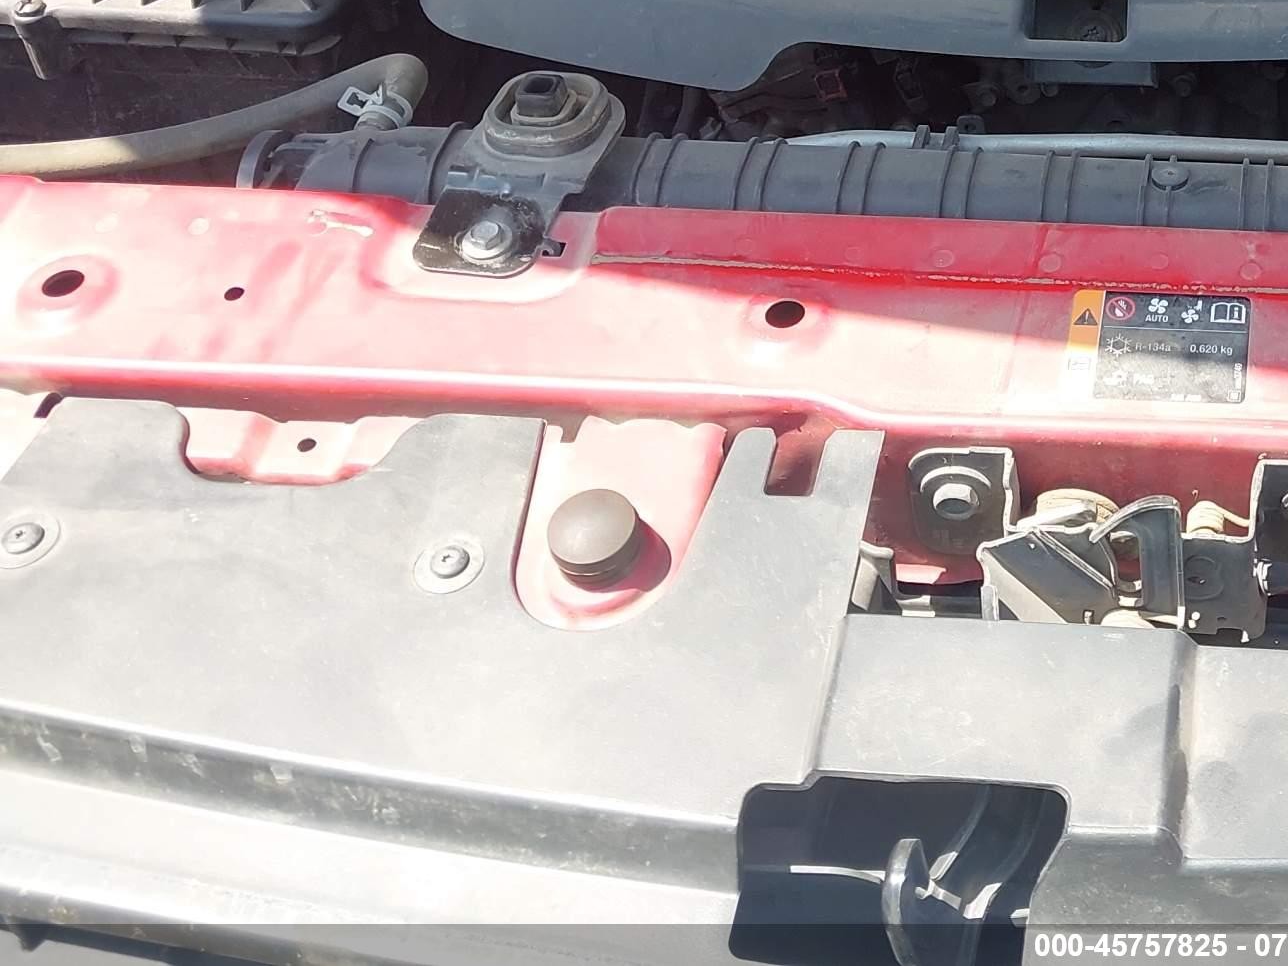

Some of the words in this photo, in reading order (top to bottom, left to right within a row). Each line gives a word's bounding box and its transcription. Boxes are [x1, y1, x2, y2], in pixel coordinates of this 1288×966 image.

[1145, 314, 1169, 323] AUTO
[1135, 343, 1172, 352] R-134a
[1189, 344, 1218, 354] 0.620
[1220, 345, 1233, 356] kg
